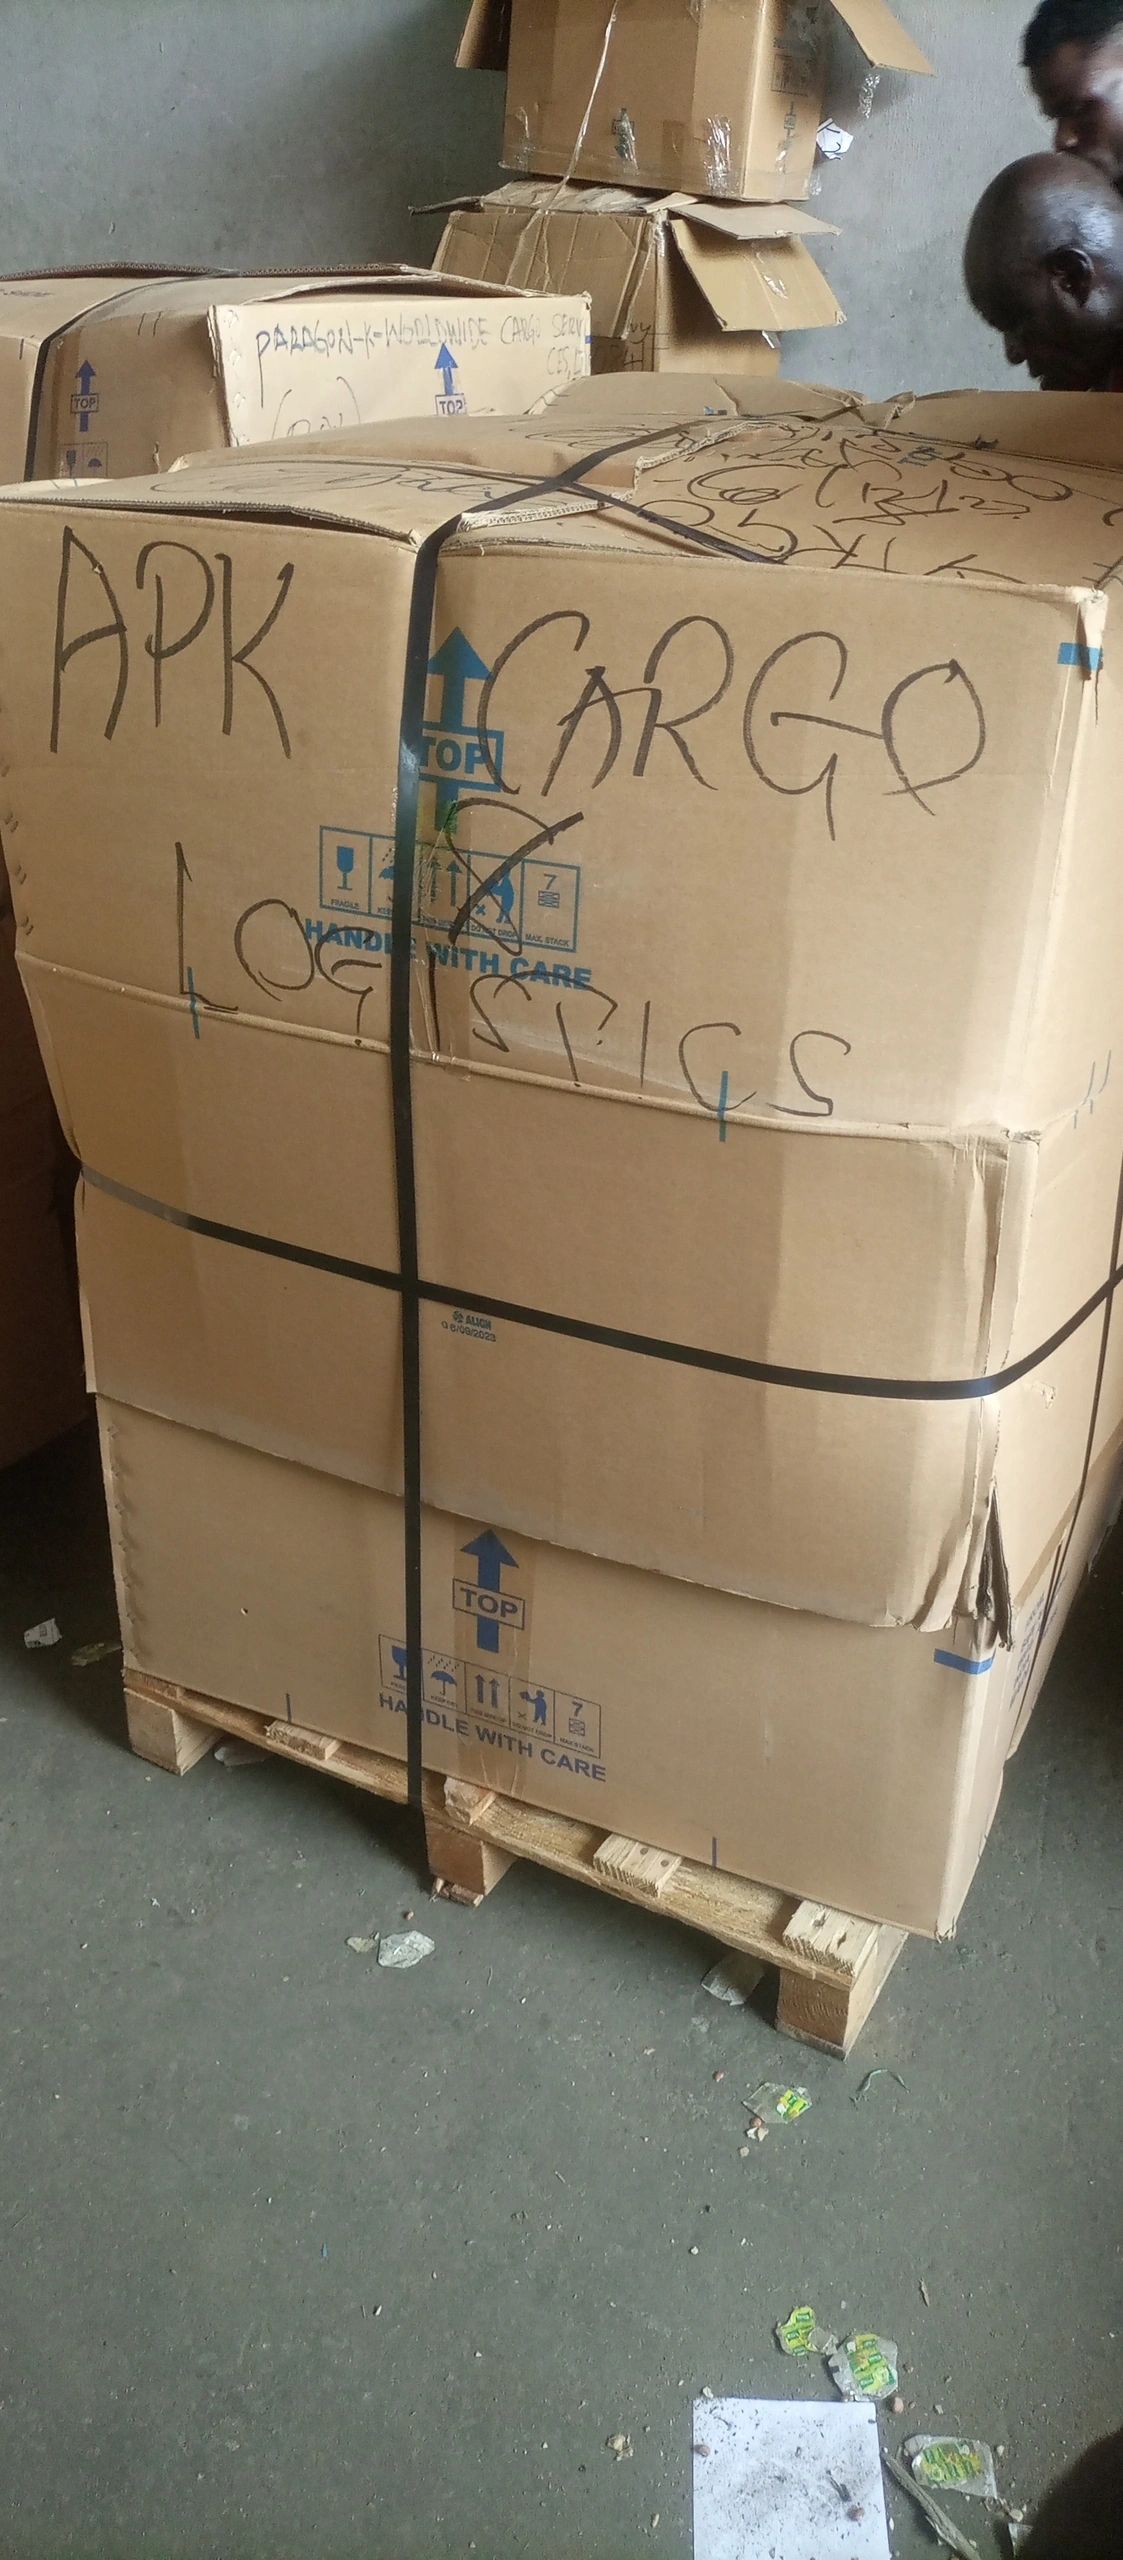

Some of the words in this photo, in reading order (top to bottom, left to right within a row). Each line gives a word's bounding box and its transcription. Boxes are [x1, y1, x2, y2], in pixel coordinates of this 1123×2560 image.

[74, 398, 96, 410] TOP
[439, 400, 463, 415] TOP
[50, 525, 294, 760] APK
[476, 609, 987, 842] CARGO
[418, 735, 490, 775] TOP
[543, 873, 558, 890] 7
[425, 940, 500, 974] WITH
[511, 956, 593, 992] CARE
[459, 1586, 519, 1619] TOP
[570, 1701, 584, 1717] 7
[378, 1691, 469, 1737] HADLE
[474, 1725, 534, 1758] WITH
[540, 1748, 607, 1783] CARE
